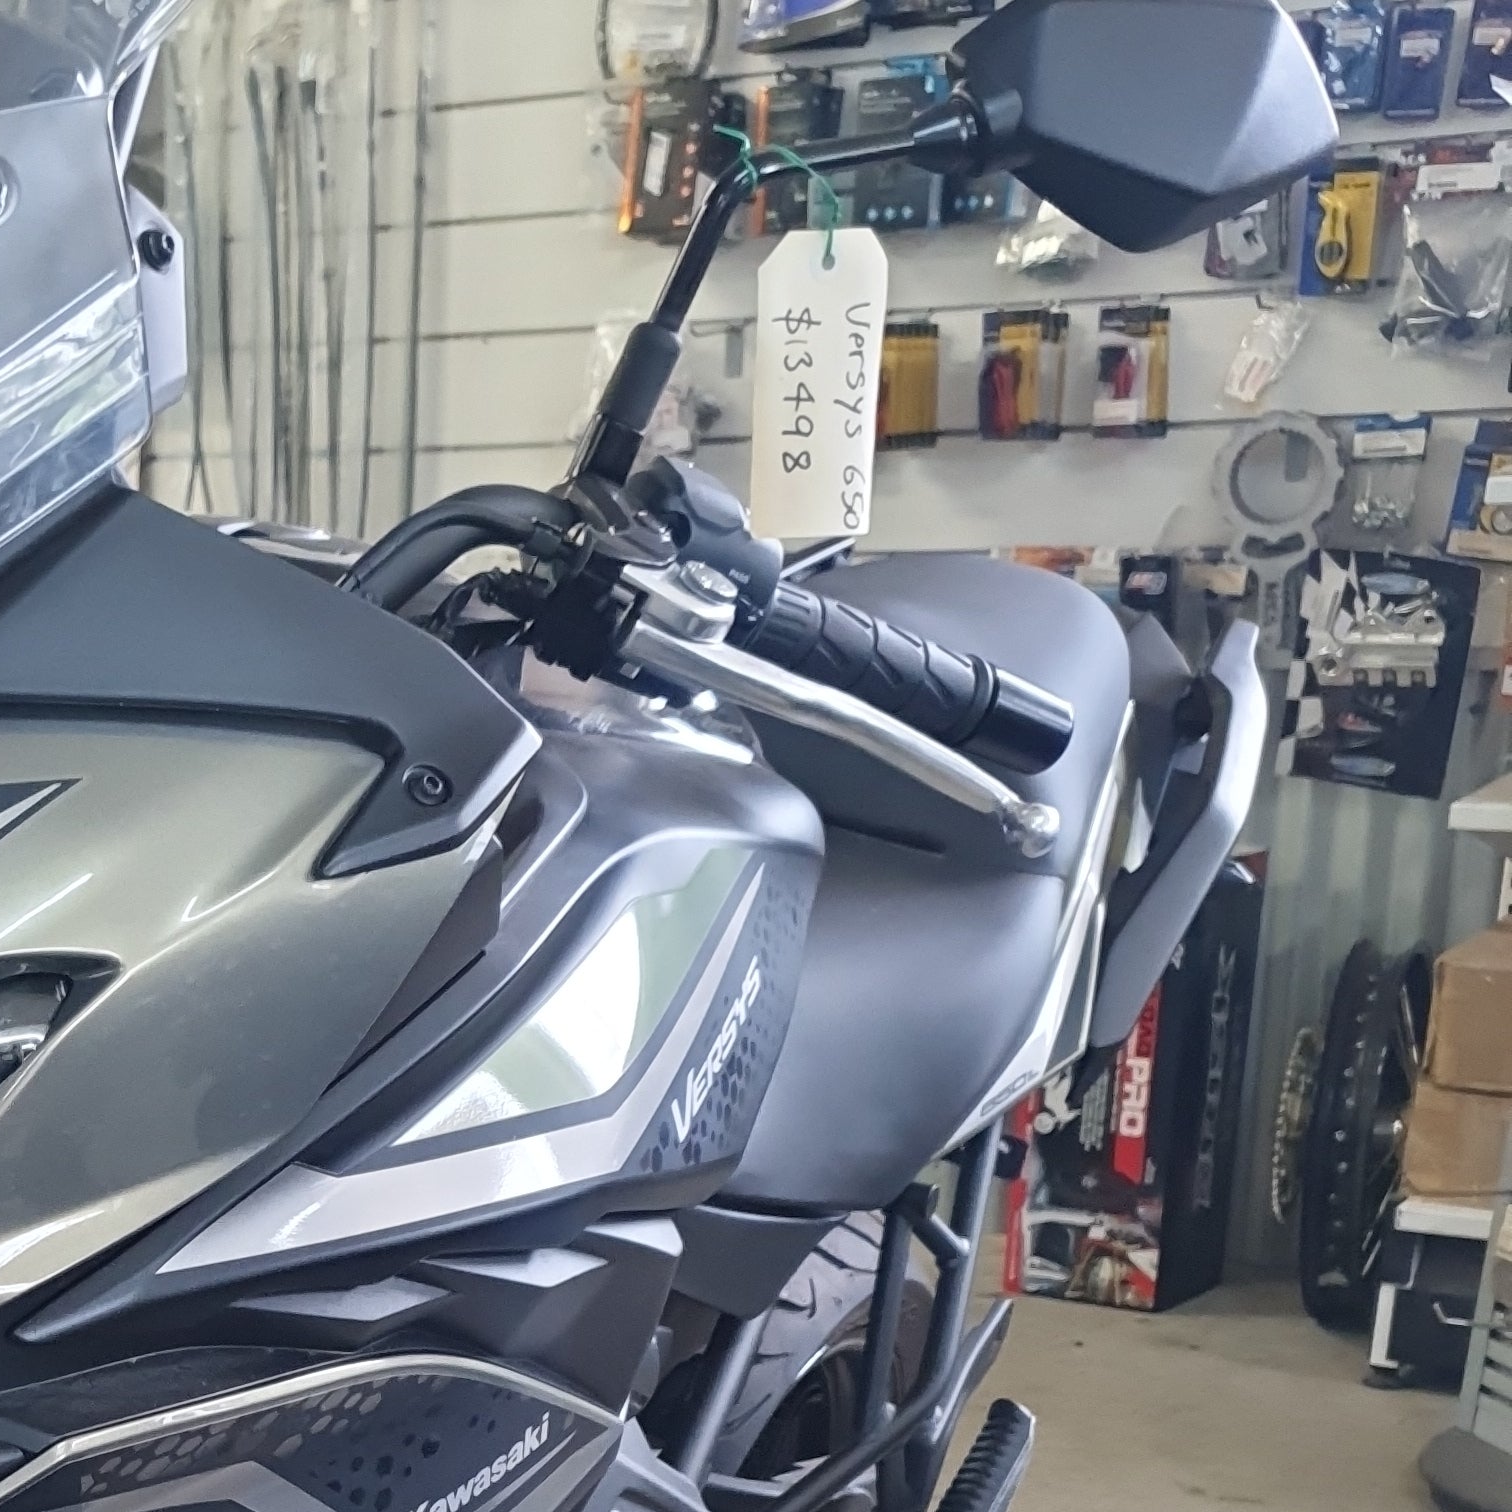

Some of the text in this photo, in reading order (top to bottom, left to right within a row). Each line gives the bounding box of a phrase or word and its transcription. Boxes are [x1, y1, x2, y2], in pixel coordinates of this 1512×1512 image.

[772, 307, 822, 473] $13498
[833, 302, 872, 530] Versys 650
[671, 954, 762, 1144] VERSYS
[1119, 1056, 1153, 1138] PRO
